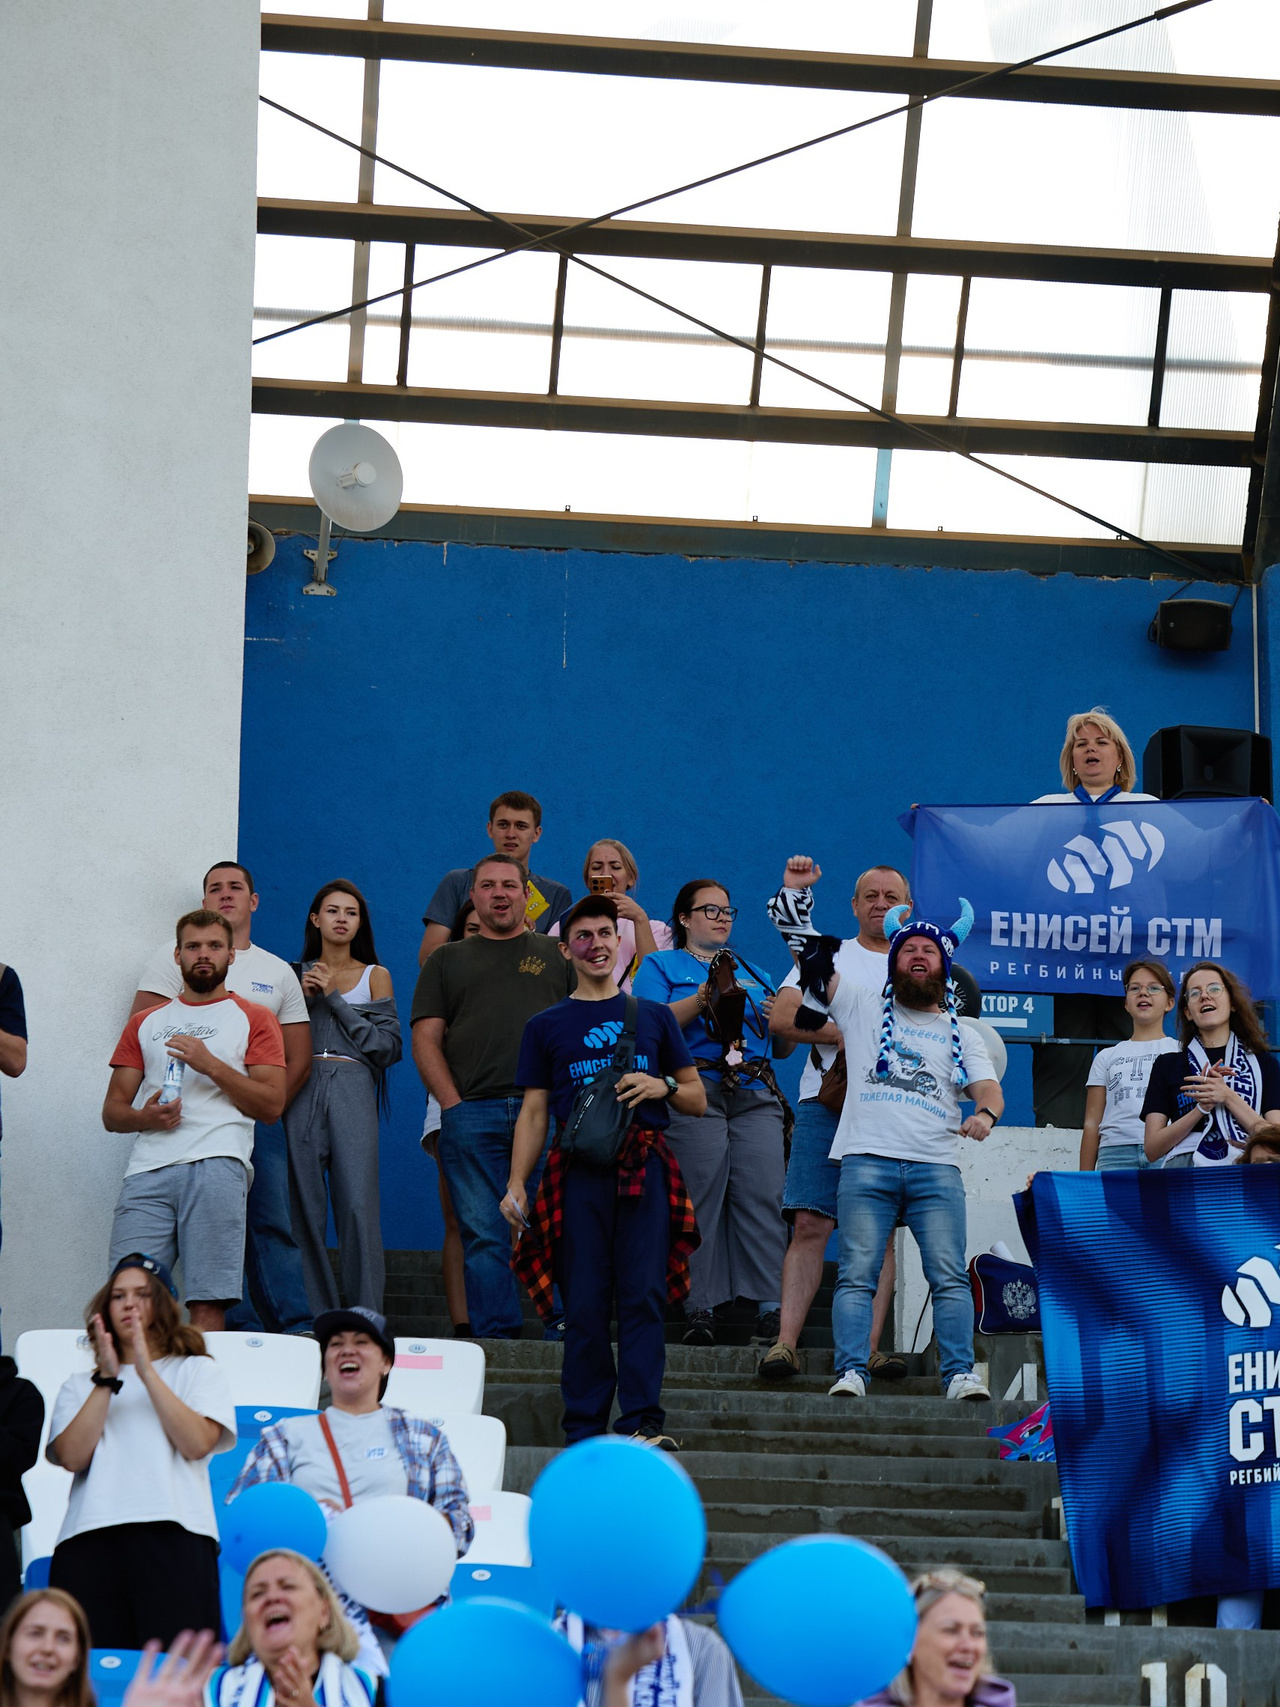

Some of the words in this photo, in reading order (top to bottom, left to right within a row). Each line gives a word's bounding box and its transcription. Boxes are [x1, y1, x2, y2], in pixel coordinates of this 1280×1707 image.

[990, 905, 1133, 955] ЕНИСЕЙ
[1146, 917, 1223, 958] СТМ
[990, 961, 1122, 981] РЕГБИЙНЫ
[981, 995, 1019, 1013] КТОР
[1022, 995, 1035, 1014] 4
[859, 1091, 903, 1103] ТЯЖЕЛАЯ
[904, 1093, 947, 1120] МАШИНА
[1141, 1661, 1228, 1707] 10
